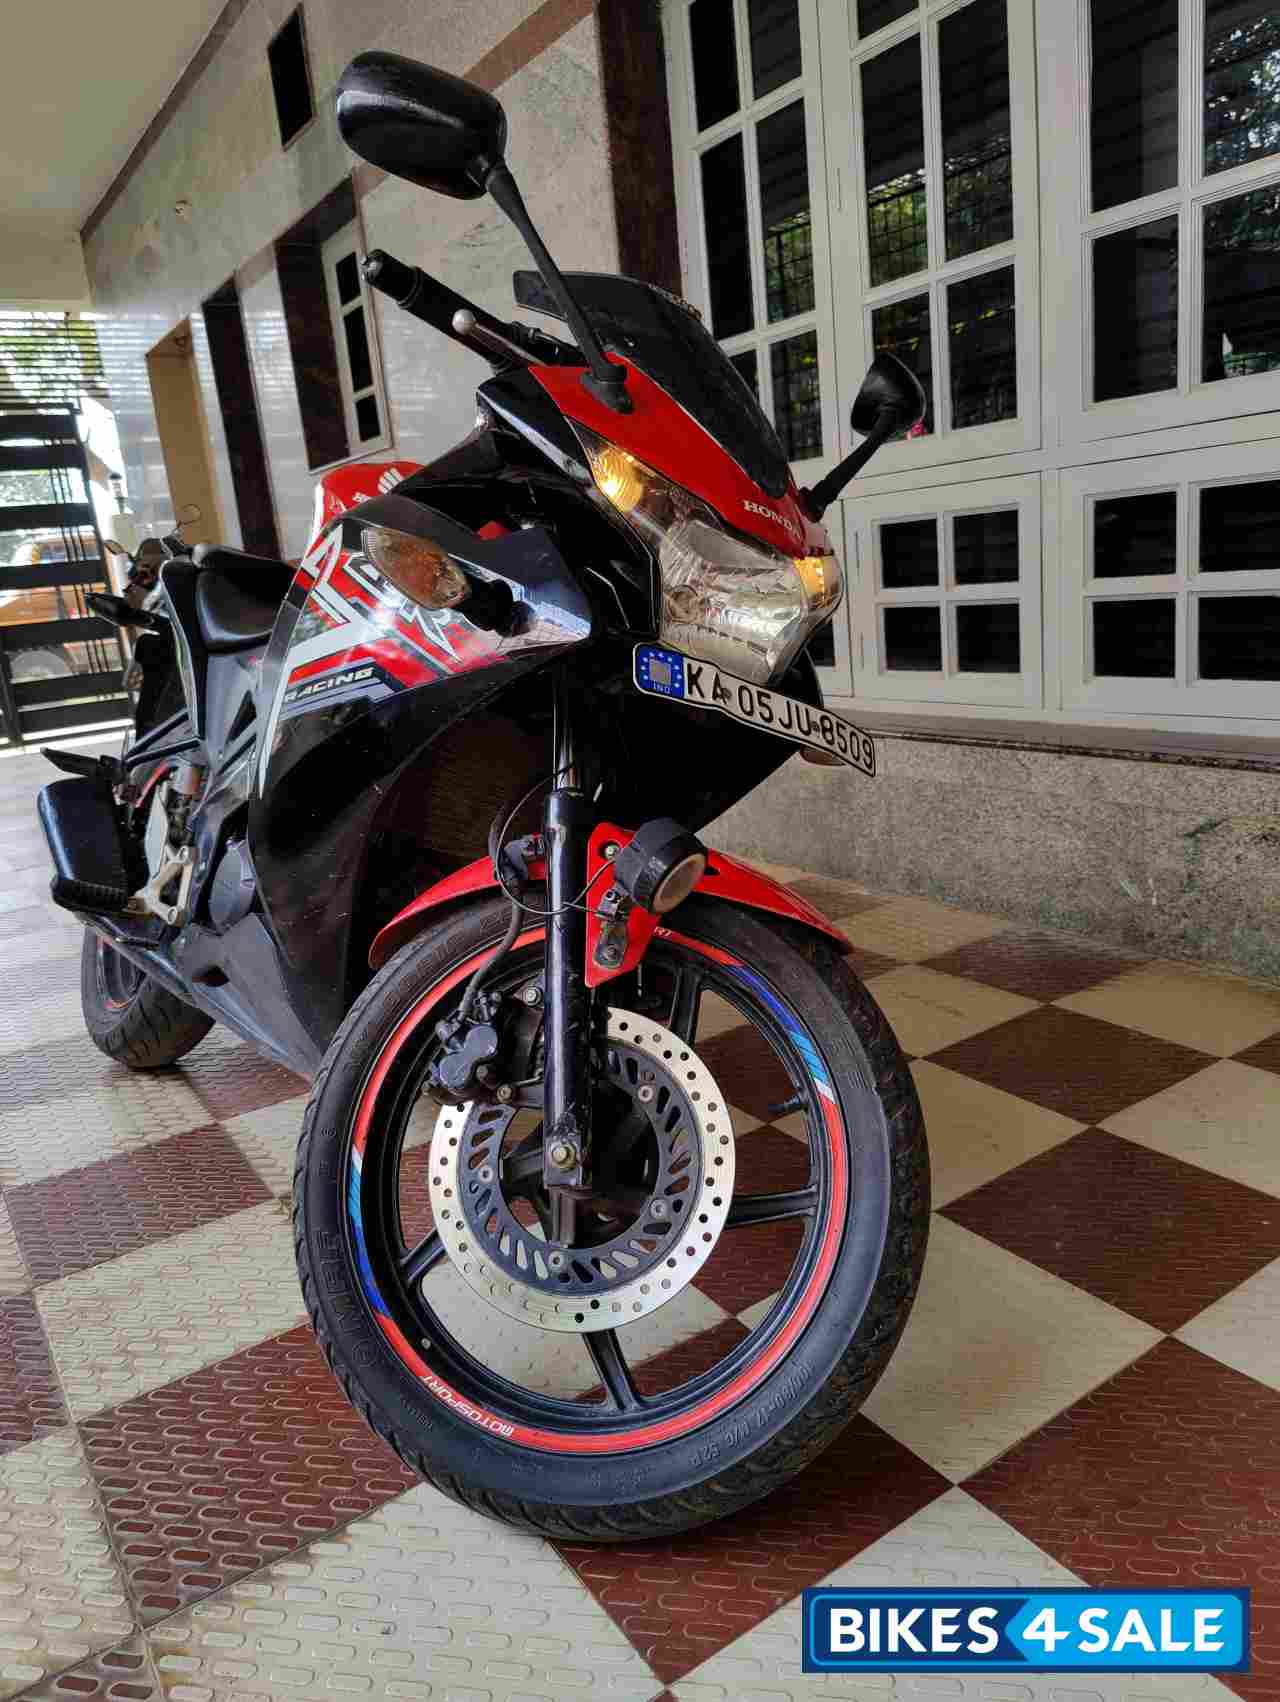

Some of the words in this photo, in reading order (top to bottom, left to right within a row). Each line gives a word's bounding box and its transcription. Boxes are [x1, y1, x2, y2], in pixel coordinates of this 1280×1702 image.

[742, 499, 802, 539] HONDA
[284, 666, 375, 703] RACING
[819, 715, 874, 769] 8509
[422, 1375, 515, 1438] MOTOSPORT
